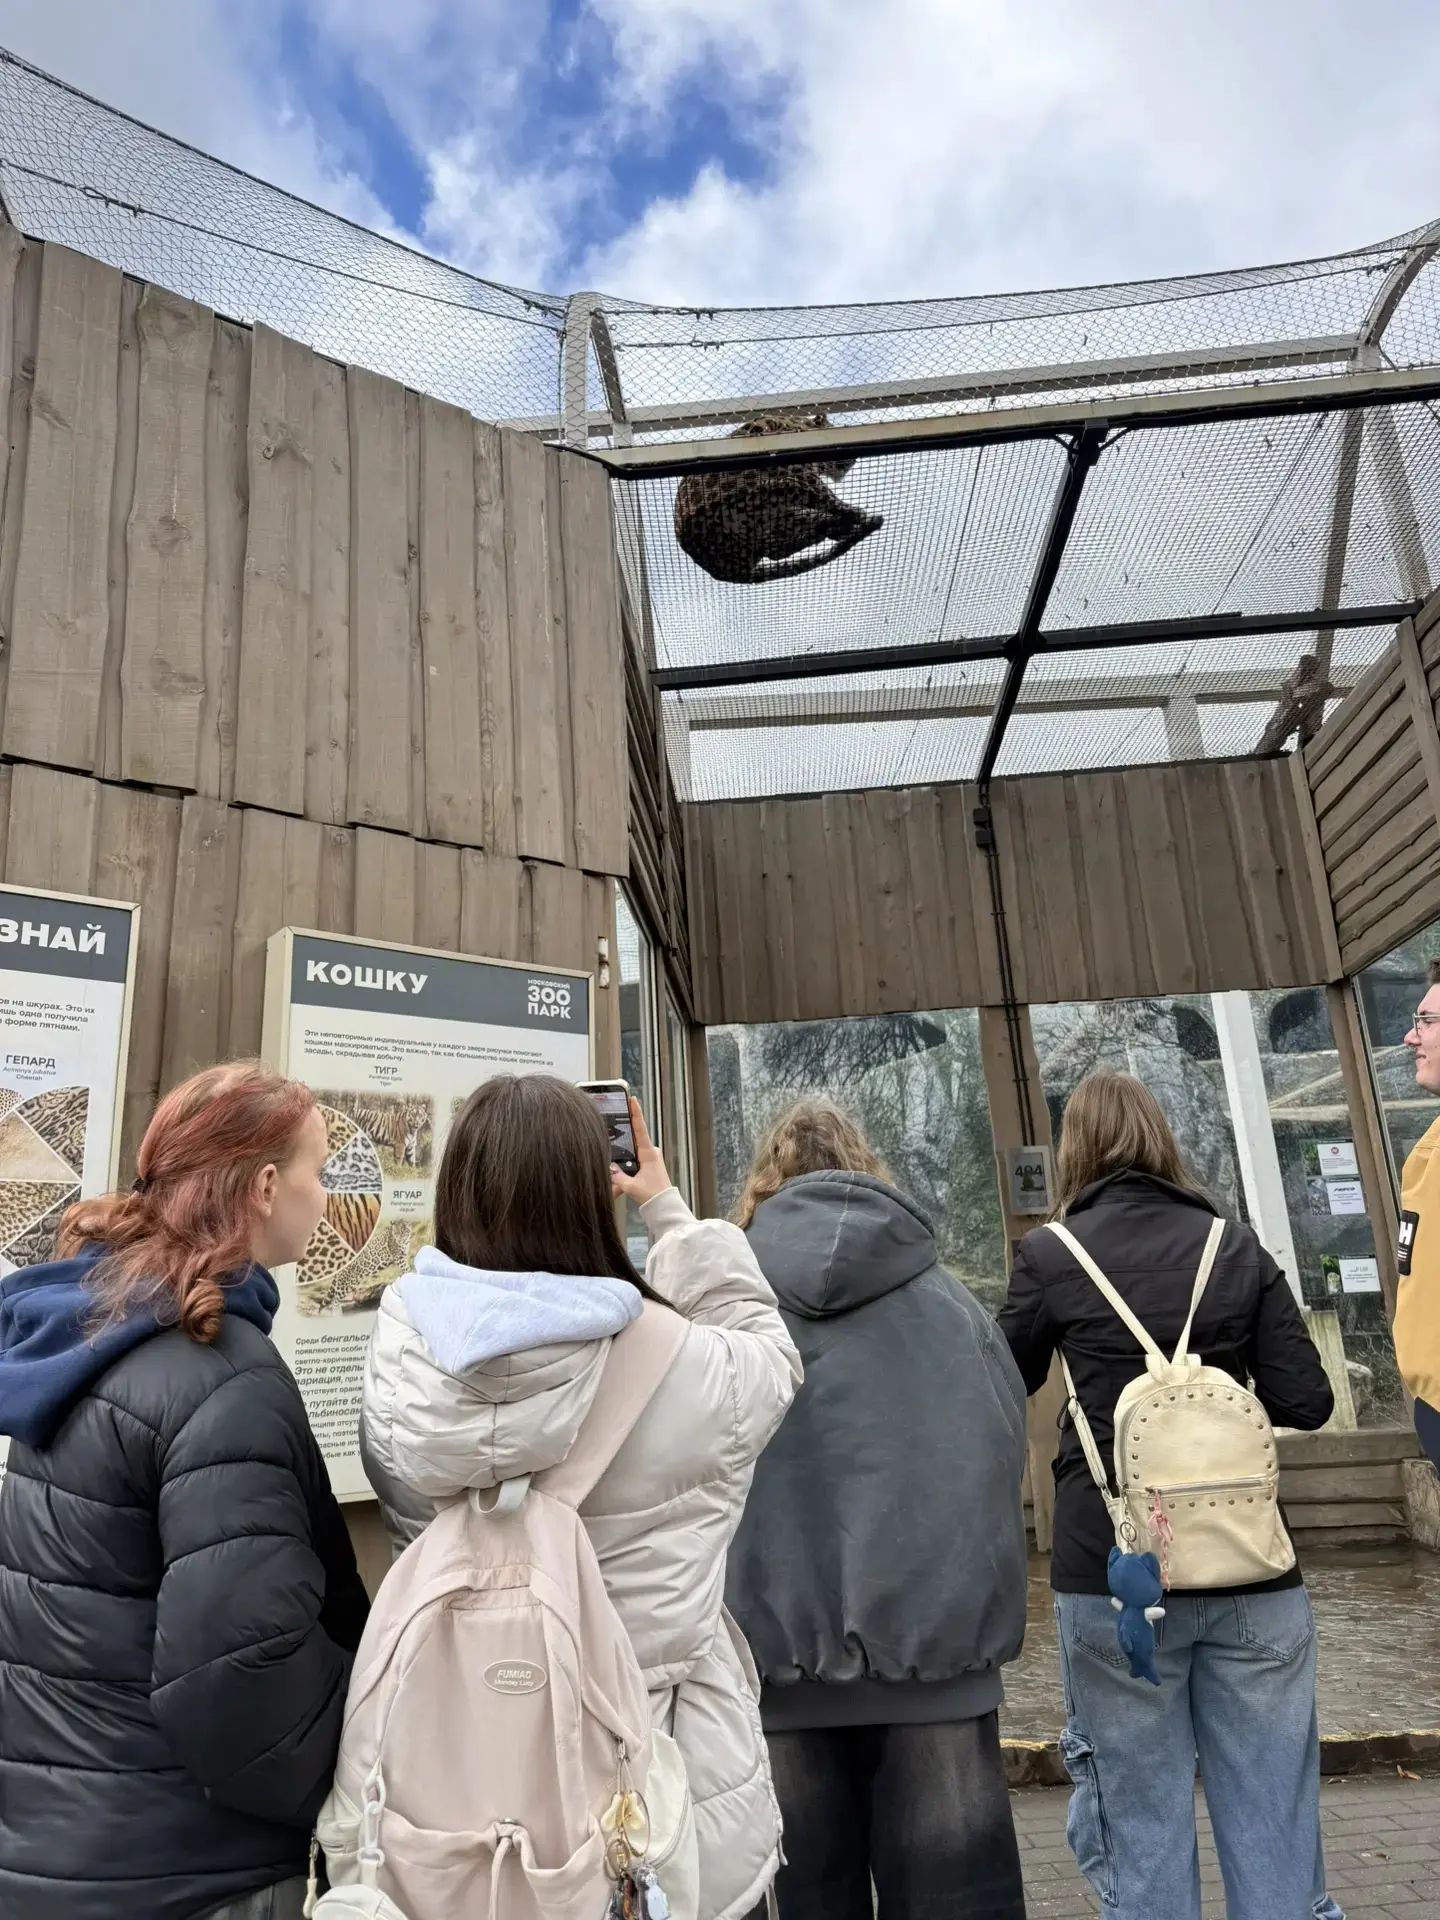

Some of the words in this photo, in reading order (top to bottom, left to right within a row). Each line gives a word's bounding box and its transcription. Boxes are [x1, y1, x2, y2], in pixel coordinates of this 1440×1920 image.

[0, 918, 106, 955] ЗНАЙ
[306, 960, 428, 994] КОШКУ
[528, 979, 570, 990] МОСКОВСКИЙ
[528, 985, 571, 1006] ЗОО
[26, 1001, 63, 1011] шкурах.
[65, 1004, 82, 1013] Это
[528, 1002, 572, 1019] ПАРК
[19, 1010, 42, 1018] одна
[44, 1012, 88, 1023] получила
[5, 1018, 37, 1028] форме
[39, 1023, 80, 1032] пятнами.
[304, 1029, 319, 1037] Эти
[391, 1045, 405, 1053] Это
[6, 1054, 55, 1069] ГЕПАРД
[374, 1066, 398, 1075] ТИГР
[393, 1190, 422, 1199] ЯГУАР
[296, 1338, 319, 1346] Среди
[295, 1347, 339, 1355] появляются
[295, 1366, 313, 1375] Это
[301, 1387, 337, 1396] сутствует
[309, 1397, 348, 1409] путайте
[308, 1407, 362, 1418] льбиносам
